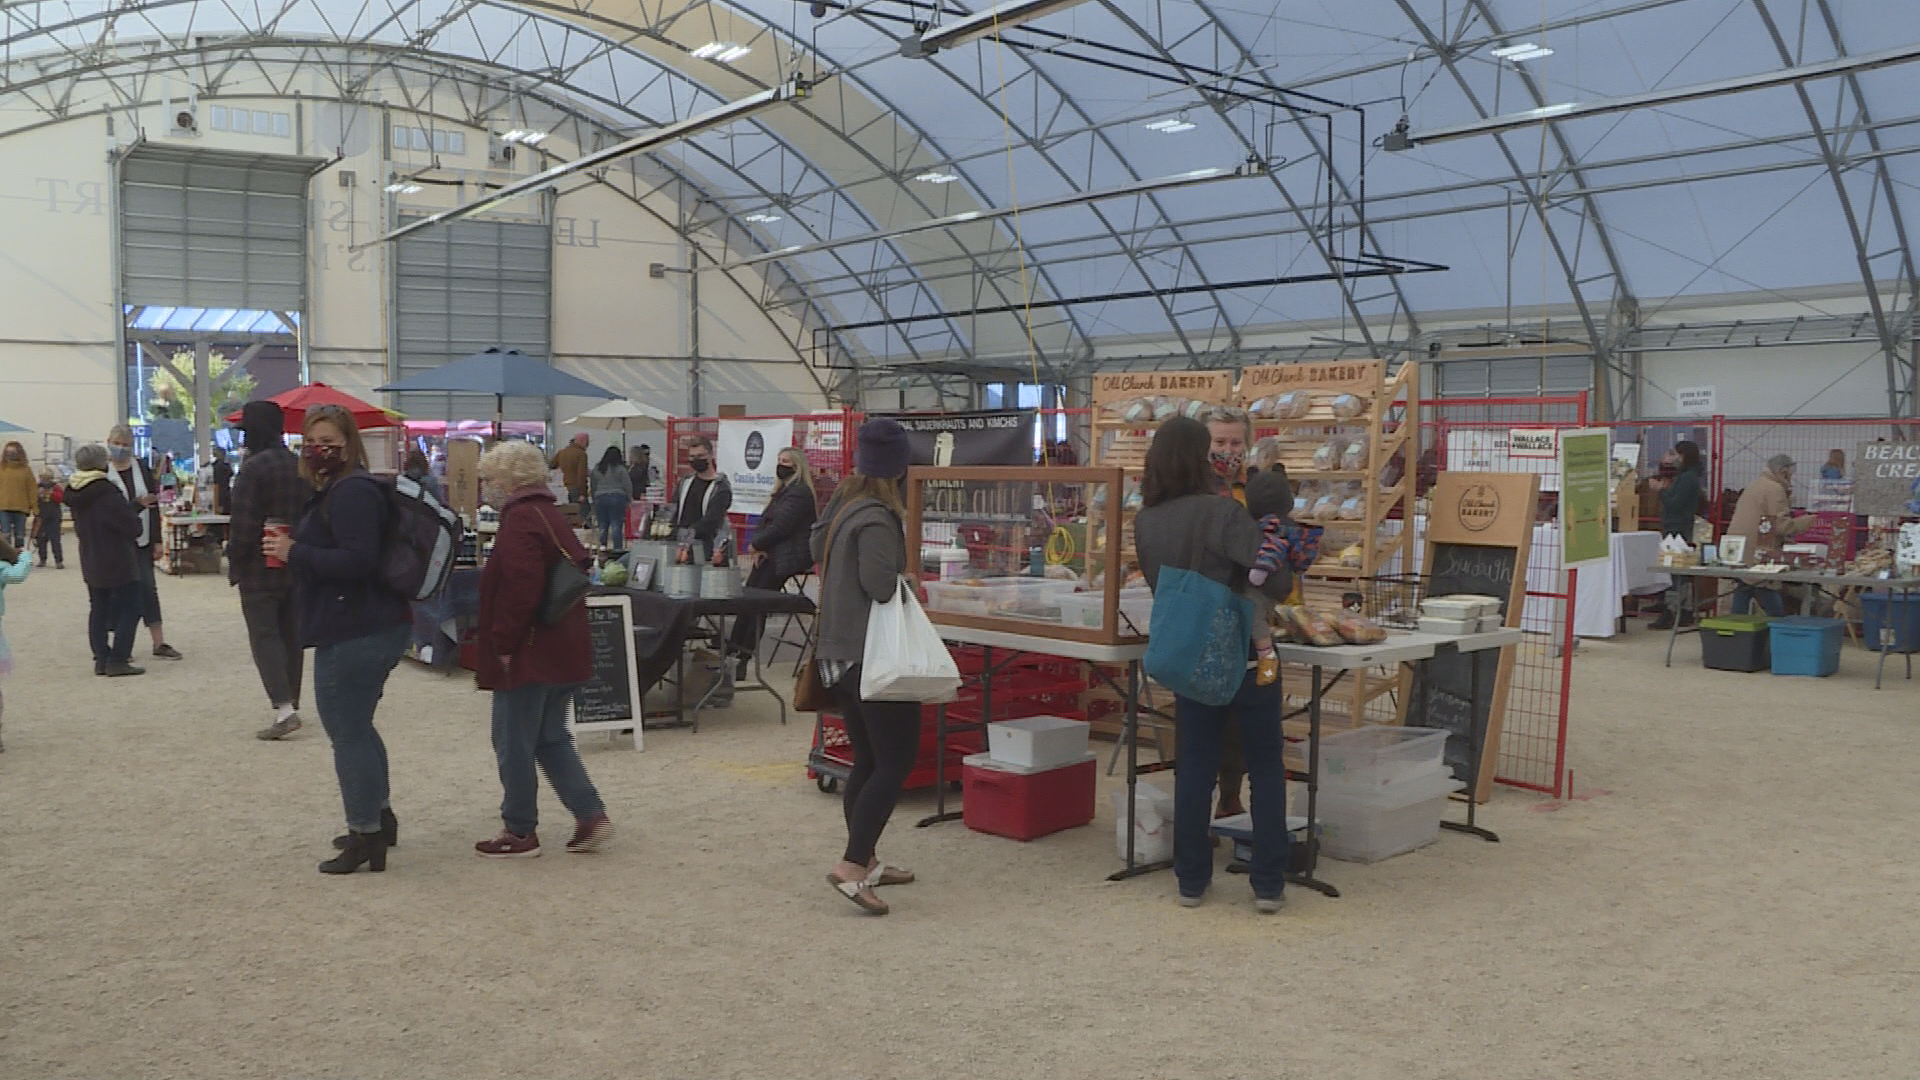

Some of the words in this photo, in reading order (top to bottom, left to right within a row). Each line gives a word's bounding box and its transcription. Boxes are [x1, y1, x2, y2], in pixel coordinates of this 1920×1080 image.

[1121, 375, 1156, 391] Church
[1160, 376, 1215, 390] BAKERY
[1270, 367, 1304, 385] Church
[1309, 366, 1366, 382] BAKERY
[915, 418, 967, 430] SAUERKRAUTS
[968, 418, 985, 429] AND
[987, 416, 1018, 428] KIMCHIS
[1513, 434, 1551, 442] WALLACE
[1864, 444, 1920, 460] BEAC
[1876, 463, 1920, 478] CRE
[1461, 508, 1495, 517] BAKERY
